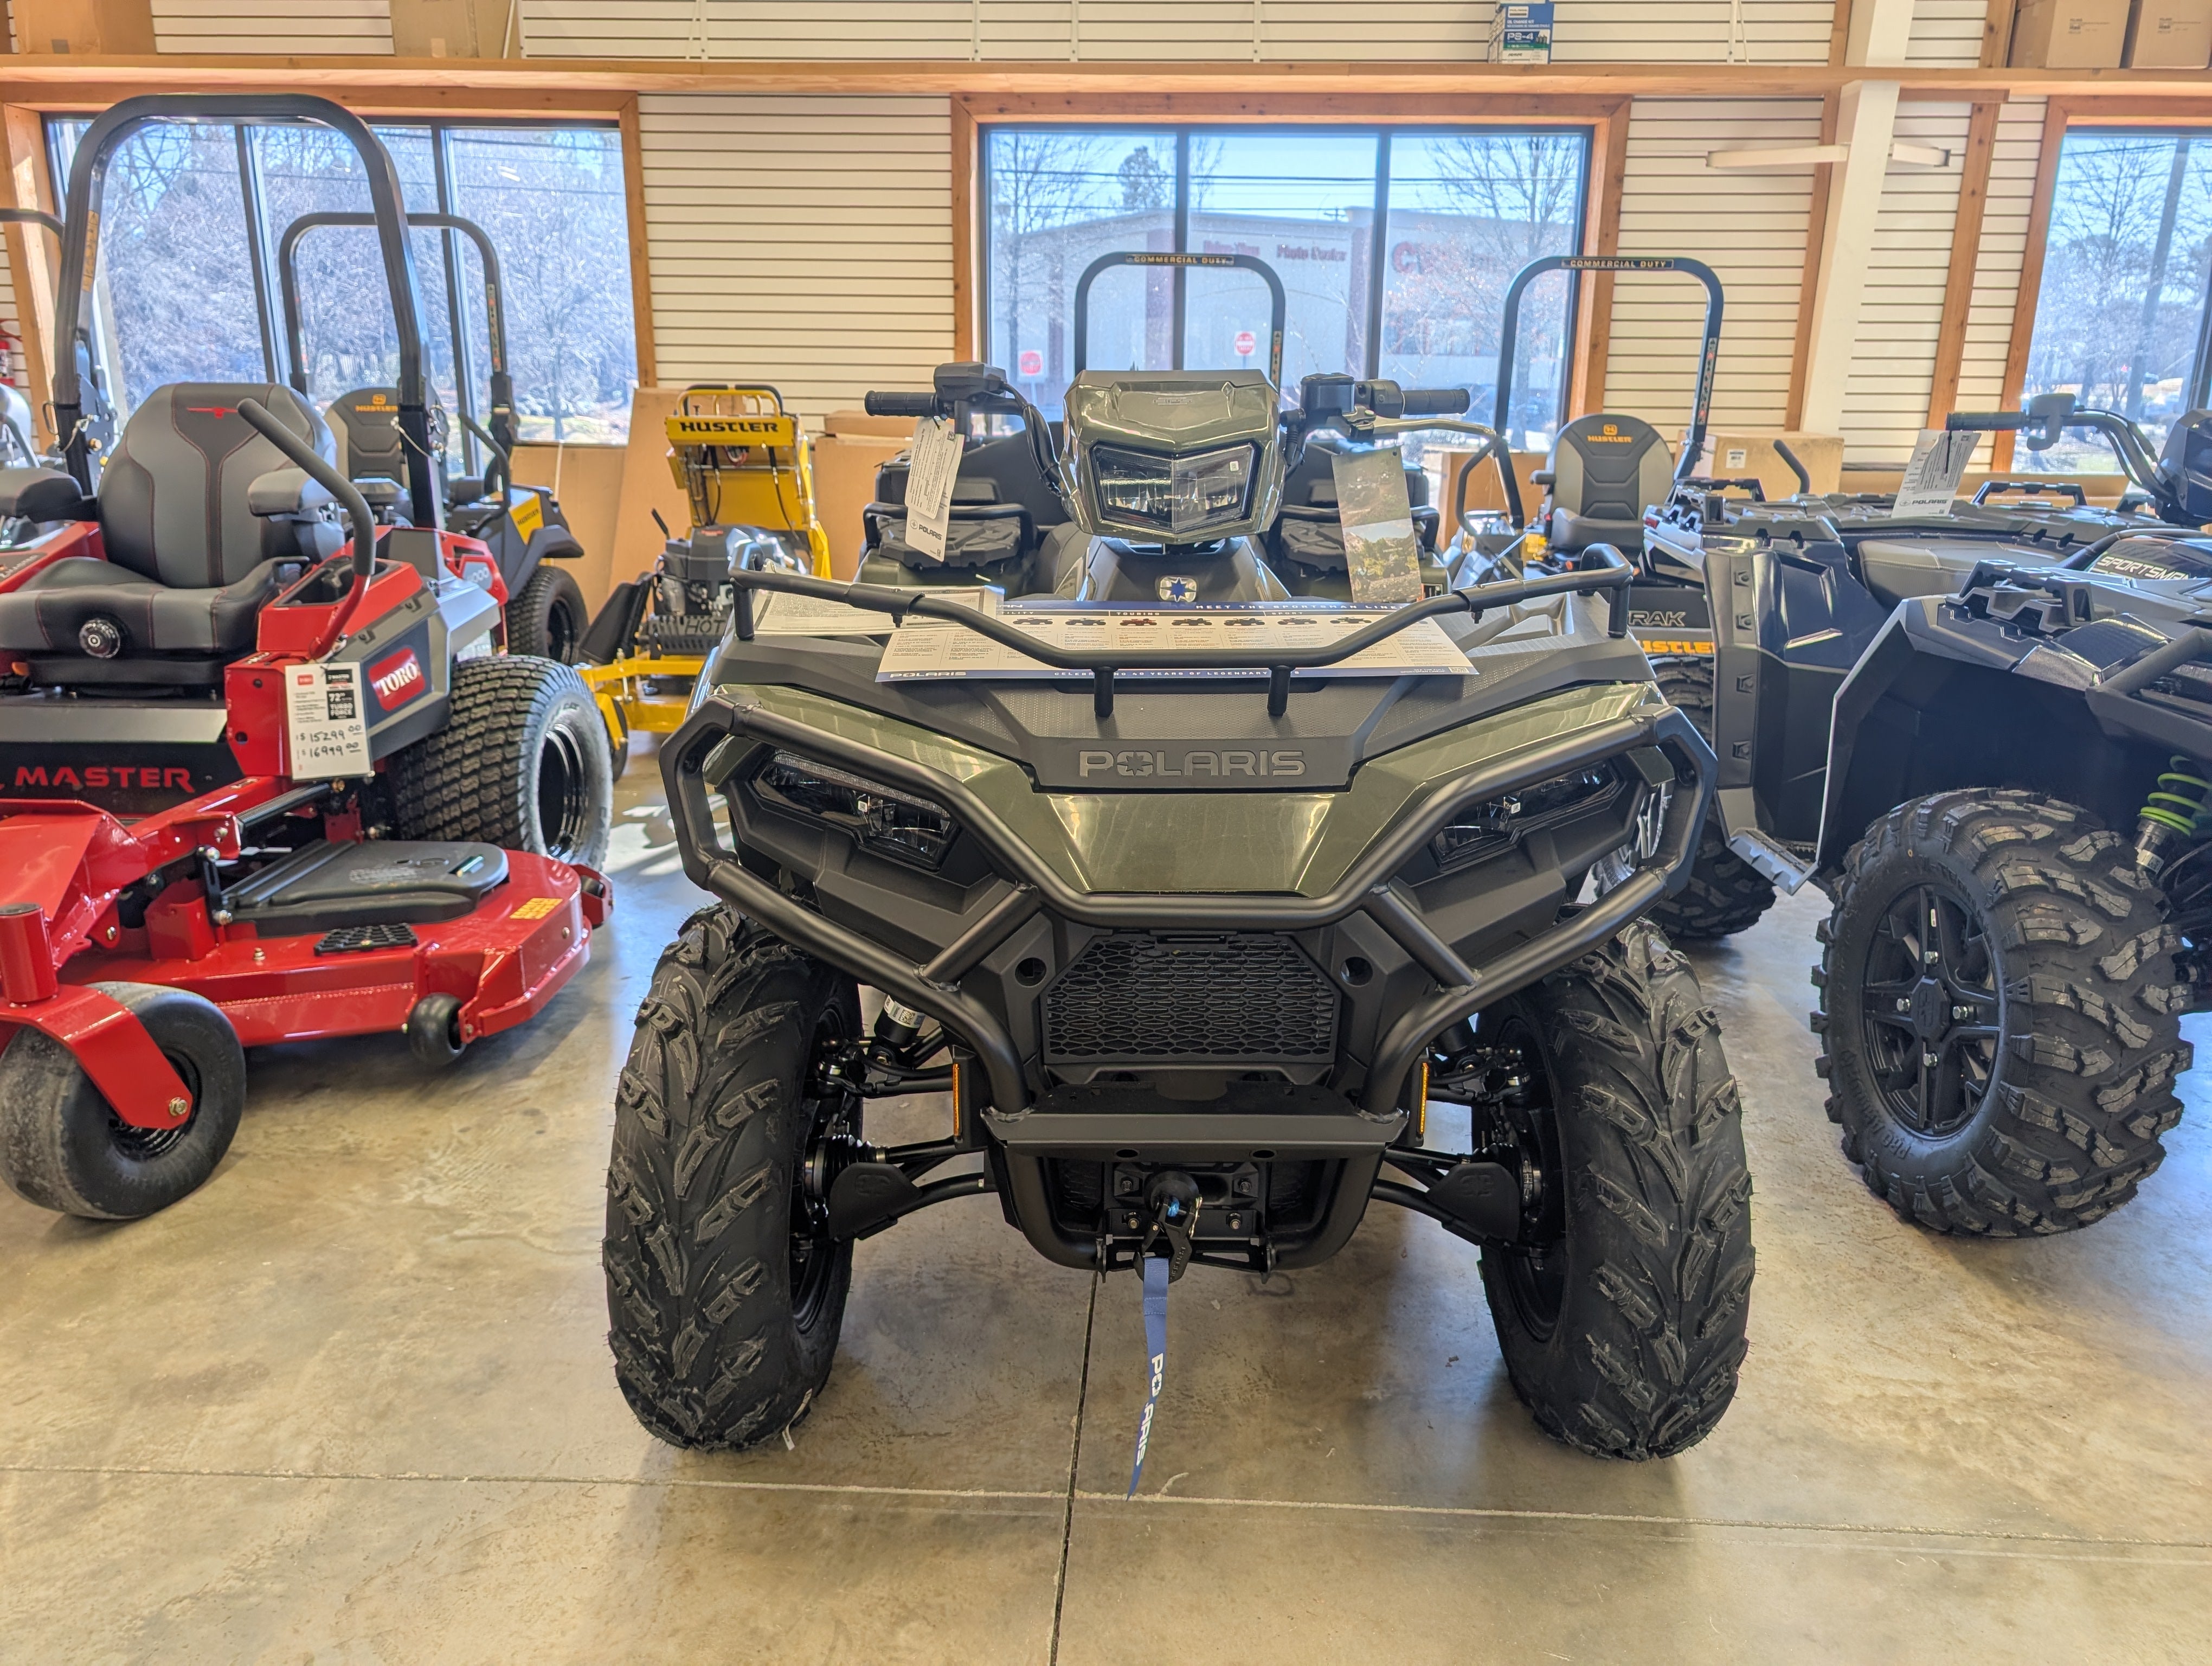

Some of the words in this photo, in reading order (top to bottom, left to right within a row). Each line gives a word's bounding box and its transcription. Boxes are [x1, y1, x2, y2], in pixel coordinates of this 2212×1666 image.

[1507, 33, 1534, 41] PS-4
[679, 422, 779, 433] HUSTLER
[918, 523, 942, 541] POLARIS
[685, 619, 725, 634] HOT
[377, 662, 417, 697] TORO
[310, 729, 346, 743] 15299
[310, 745, 344, 759] 16999
[1078, 749, 1307, 777] POLARIS
[14, 766, 196, 793] MASTER
[1135, 1352, 1165, 1468] POARIS
